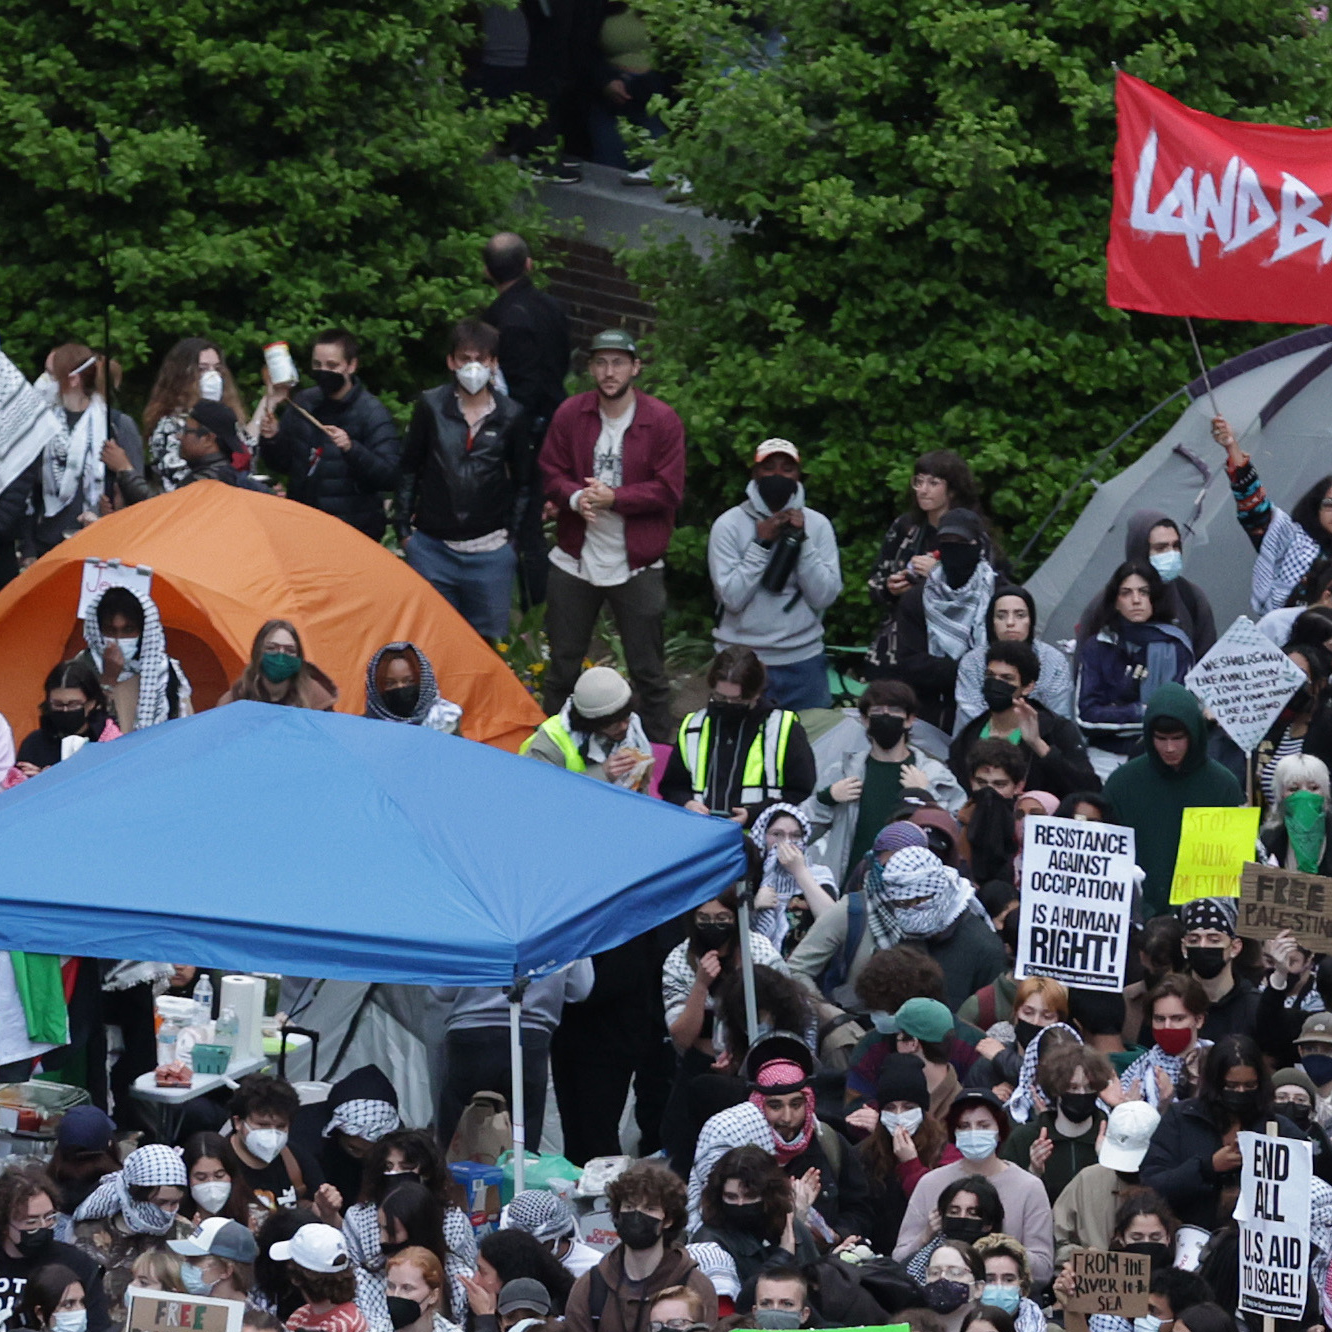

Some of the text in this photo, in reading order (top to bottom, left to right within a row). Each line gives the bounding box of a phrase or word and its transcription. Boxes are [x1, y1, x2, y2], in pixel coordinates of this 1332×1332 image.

[1034, 824, 1128, 855] RESISTANCE
[1047, 850, 1112, 877] AGAINST
[1030, 871, 1124, 902] OCCUPATION
[1256, 874, 1325, 912] FREE
[1031, 903, 1121, 934] IS HUMAN
[1029, 926, 1117, 974] RIGHT!
[1253, 1140, 1289, 1182] END
[1253, 1180, 1285, 1223] ALL
[1268, 1234, 1302, 1270] AID
[1254, 1266, 1302, 1300] ISRAEL!
[154, 1300, 207, 1331] FREE
[1097, 1295, 1122, 1311] SEA
